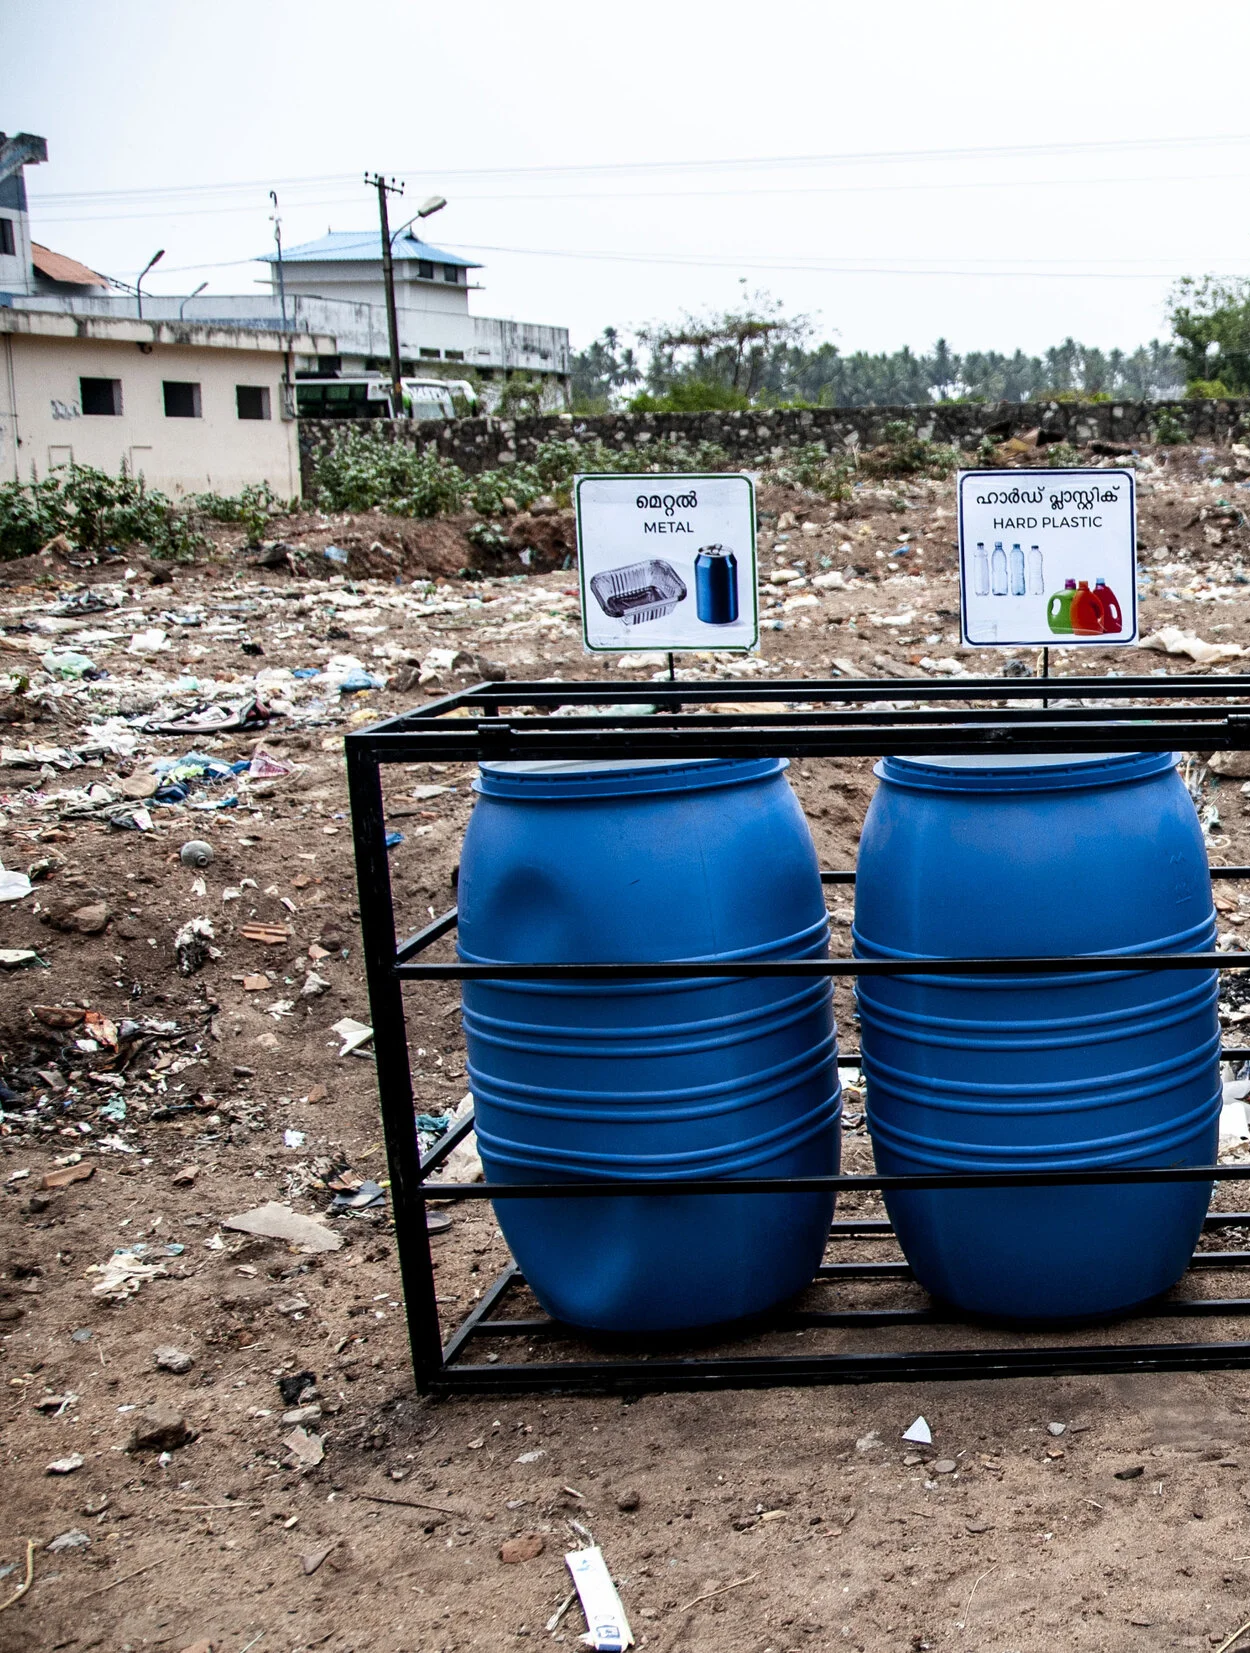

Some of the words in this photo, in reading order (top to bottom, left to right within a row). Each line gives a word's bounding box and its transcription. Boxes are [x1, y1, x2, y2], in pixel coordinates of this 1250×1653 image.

[636, 490, 698, 517] മെറ്റൽ
[976, 486, 1045, 505] ഹാർഡ്
[1049, 485, 1120, 510] പ്ലാസ്റ്റിക്
[644, 521, 694, 534] METAL
[993, 517, 1038, 529] HARD
[1042, 516, 1103, 528] PLASTIC
